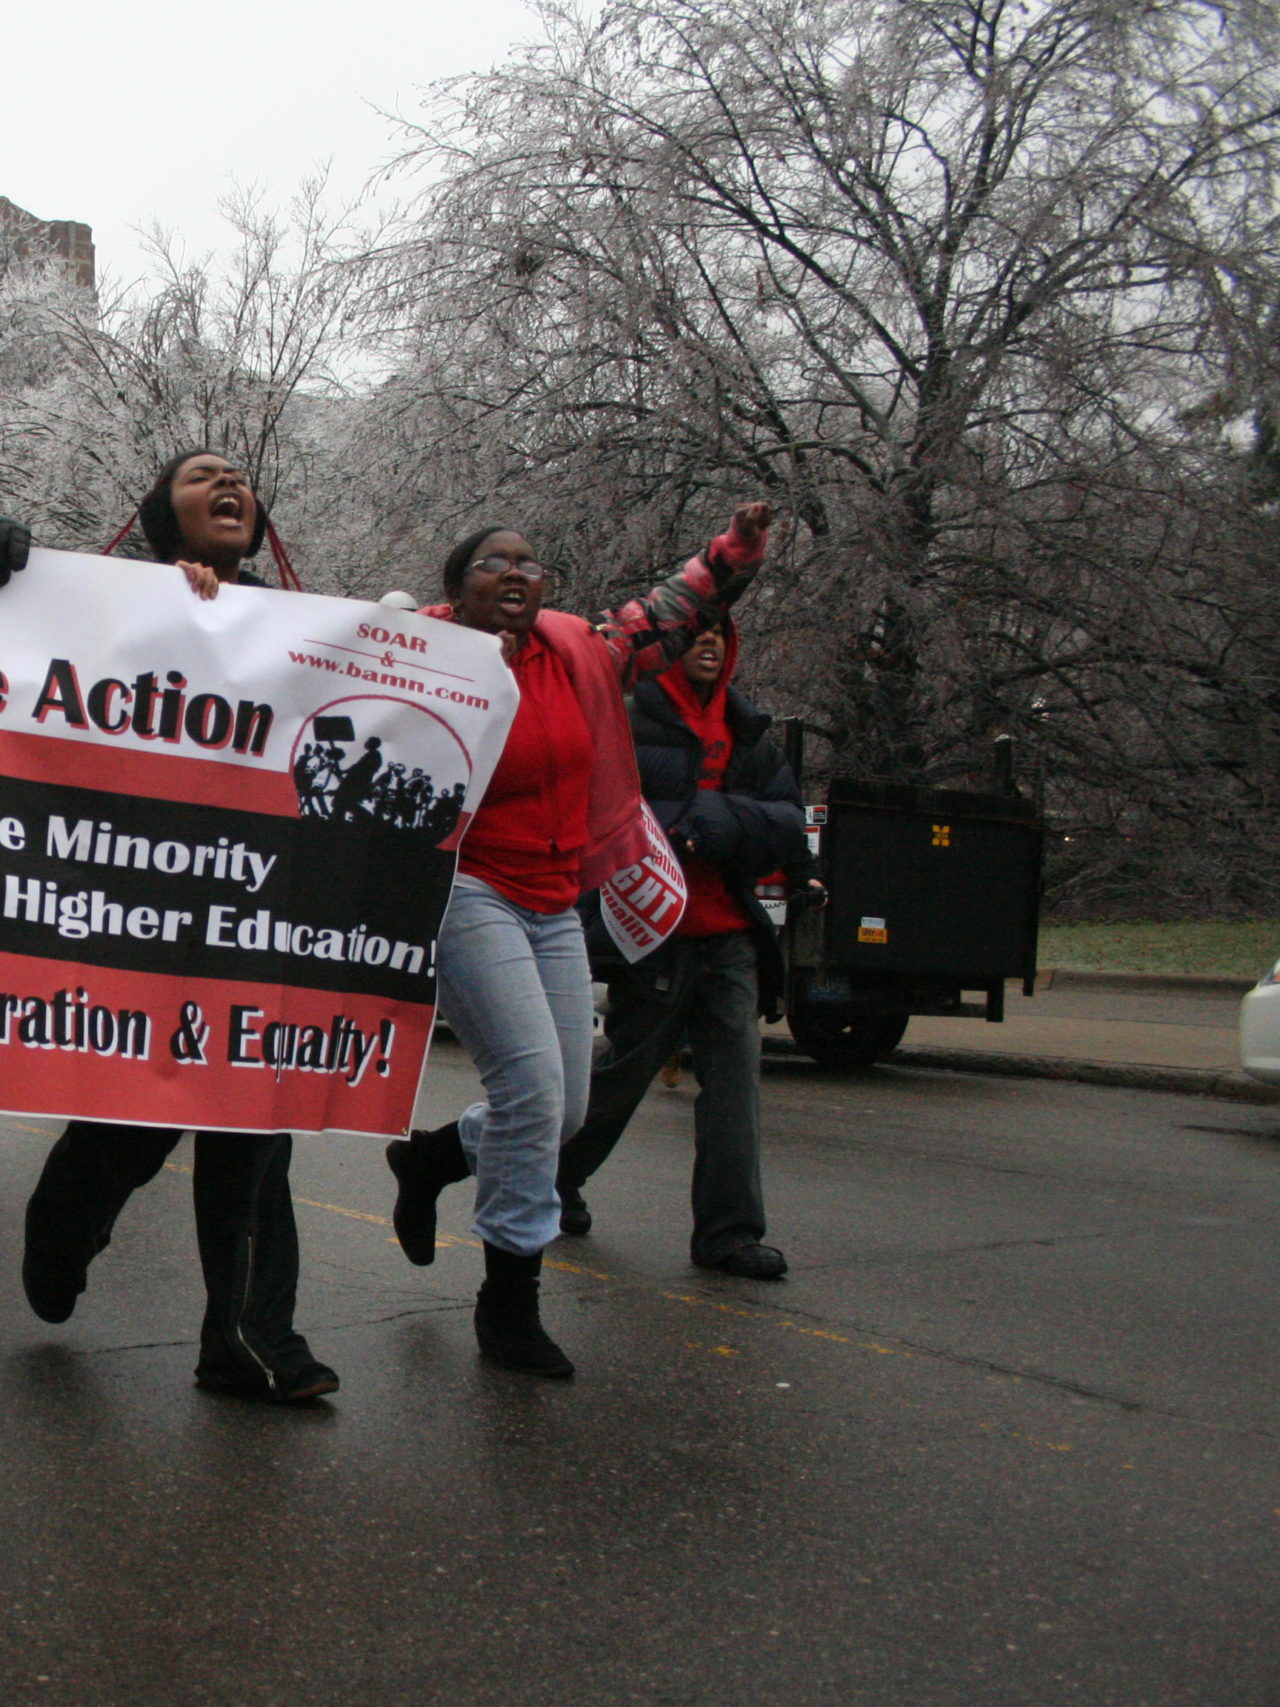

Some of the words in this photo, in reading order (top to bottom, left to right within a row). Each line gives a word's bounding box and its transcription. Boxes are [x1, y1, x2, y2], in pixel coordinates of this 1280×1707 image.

[356, 622, 428, 654] SOAR
[380, 650, 396, 668] &
[32, 658, 274, 758] Action
[287, 650, 490, 711] www.bamn.com
[46, 814, 278, 893] Minority
[3, 874, 193, 940] Higher
[205, 904, 438, 979] Education!
[611, 863, 677, 924] GHT
[169, 999, 210, 1067] &
[227, 1004, 396, 1088] Equalty!
